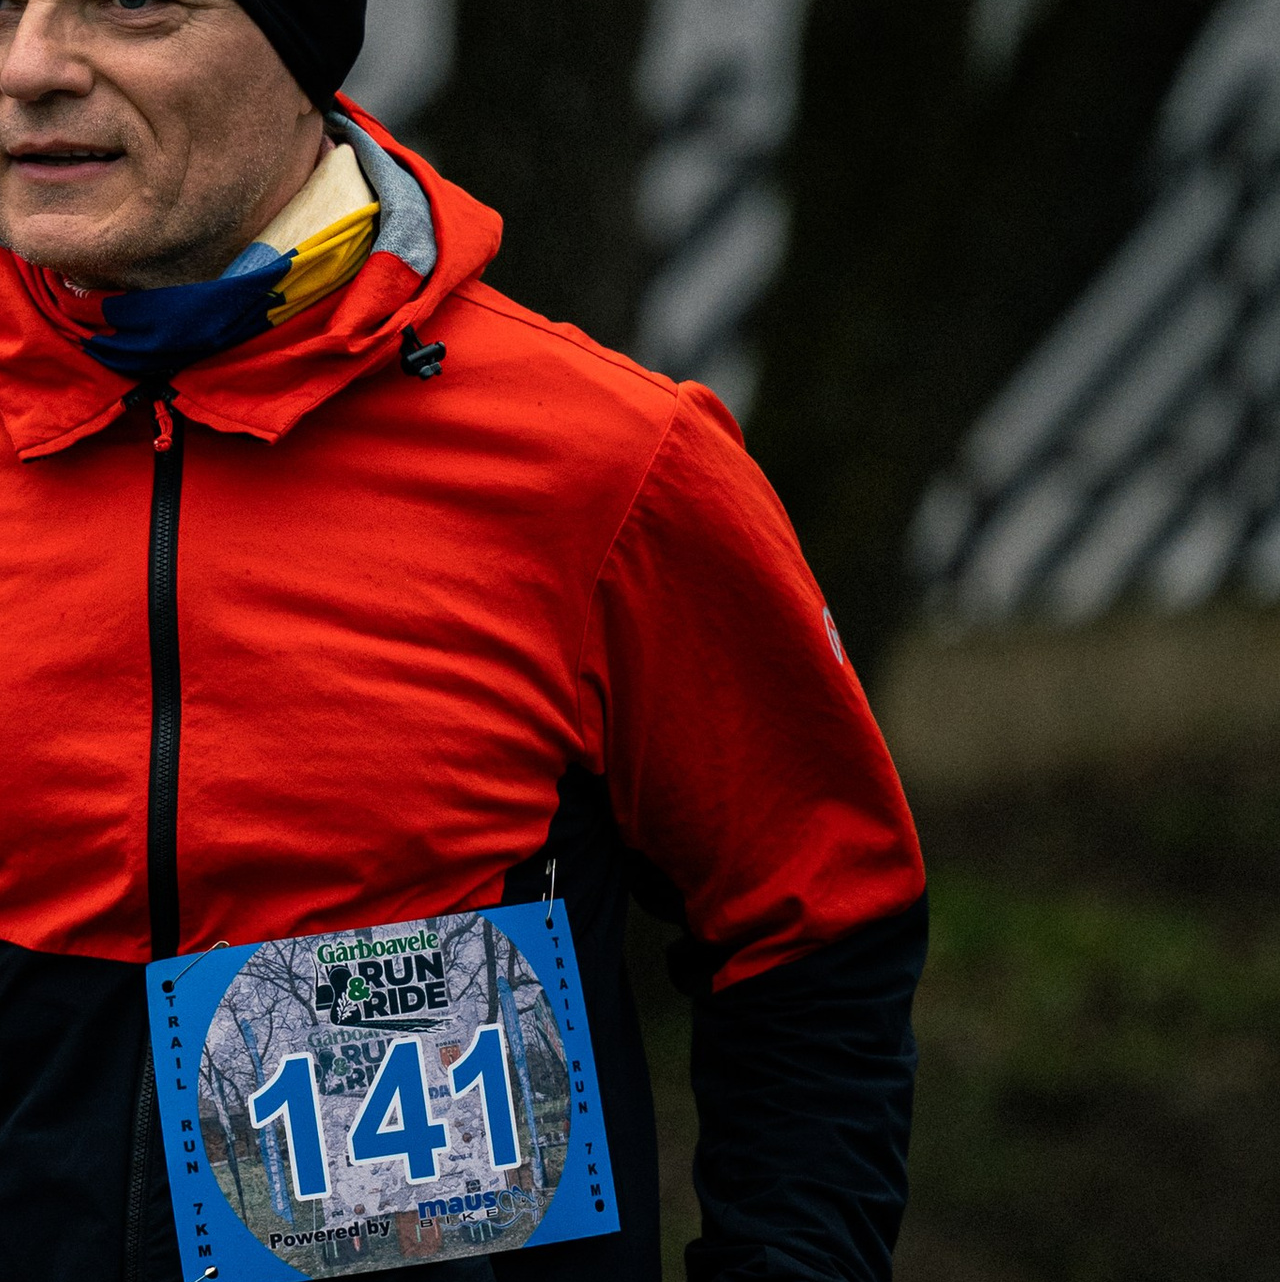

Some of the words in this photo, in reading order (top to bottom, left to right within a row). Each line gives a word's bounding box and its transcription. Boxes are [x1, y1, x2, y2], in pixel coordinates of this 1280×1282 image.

[316, 929, 440, 965] Gârboavele
[357, 951, 445, 988] RUN
[347, 976, 371, 1002] &
[364, 981, 449, 1019] RIDE
[551, 936, 575, 1032] TRAIL
[572, 1059, 589, 1115] RUN
[165, 994, 187, 1091] TRAIL
[180, 1119, 200, 1174] RUN
[250, 1025, 519, 1200] 141
[418, 1190, 498, 1218] maus
[420, 1208, 499, 1229] BIKE
[270, 1221, 361, 1249] Powered
[367, 1219, 391, 1237] by
